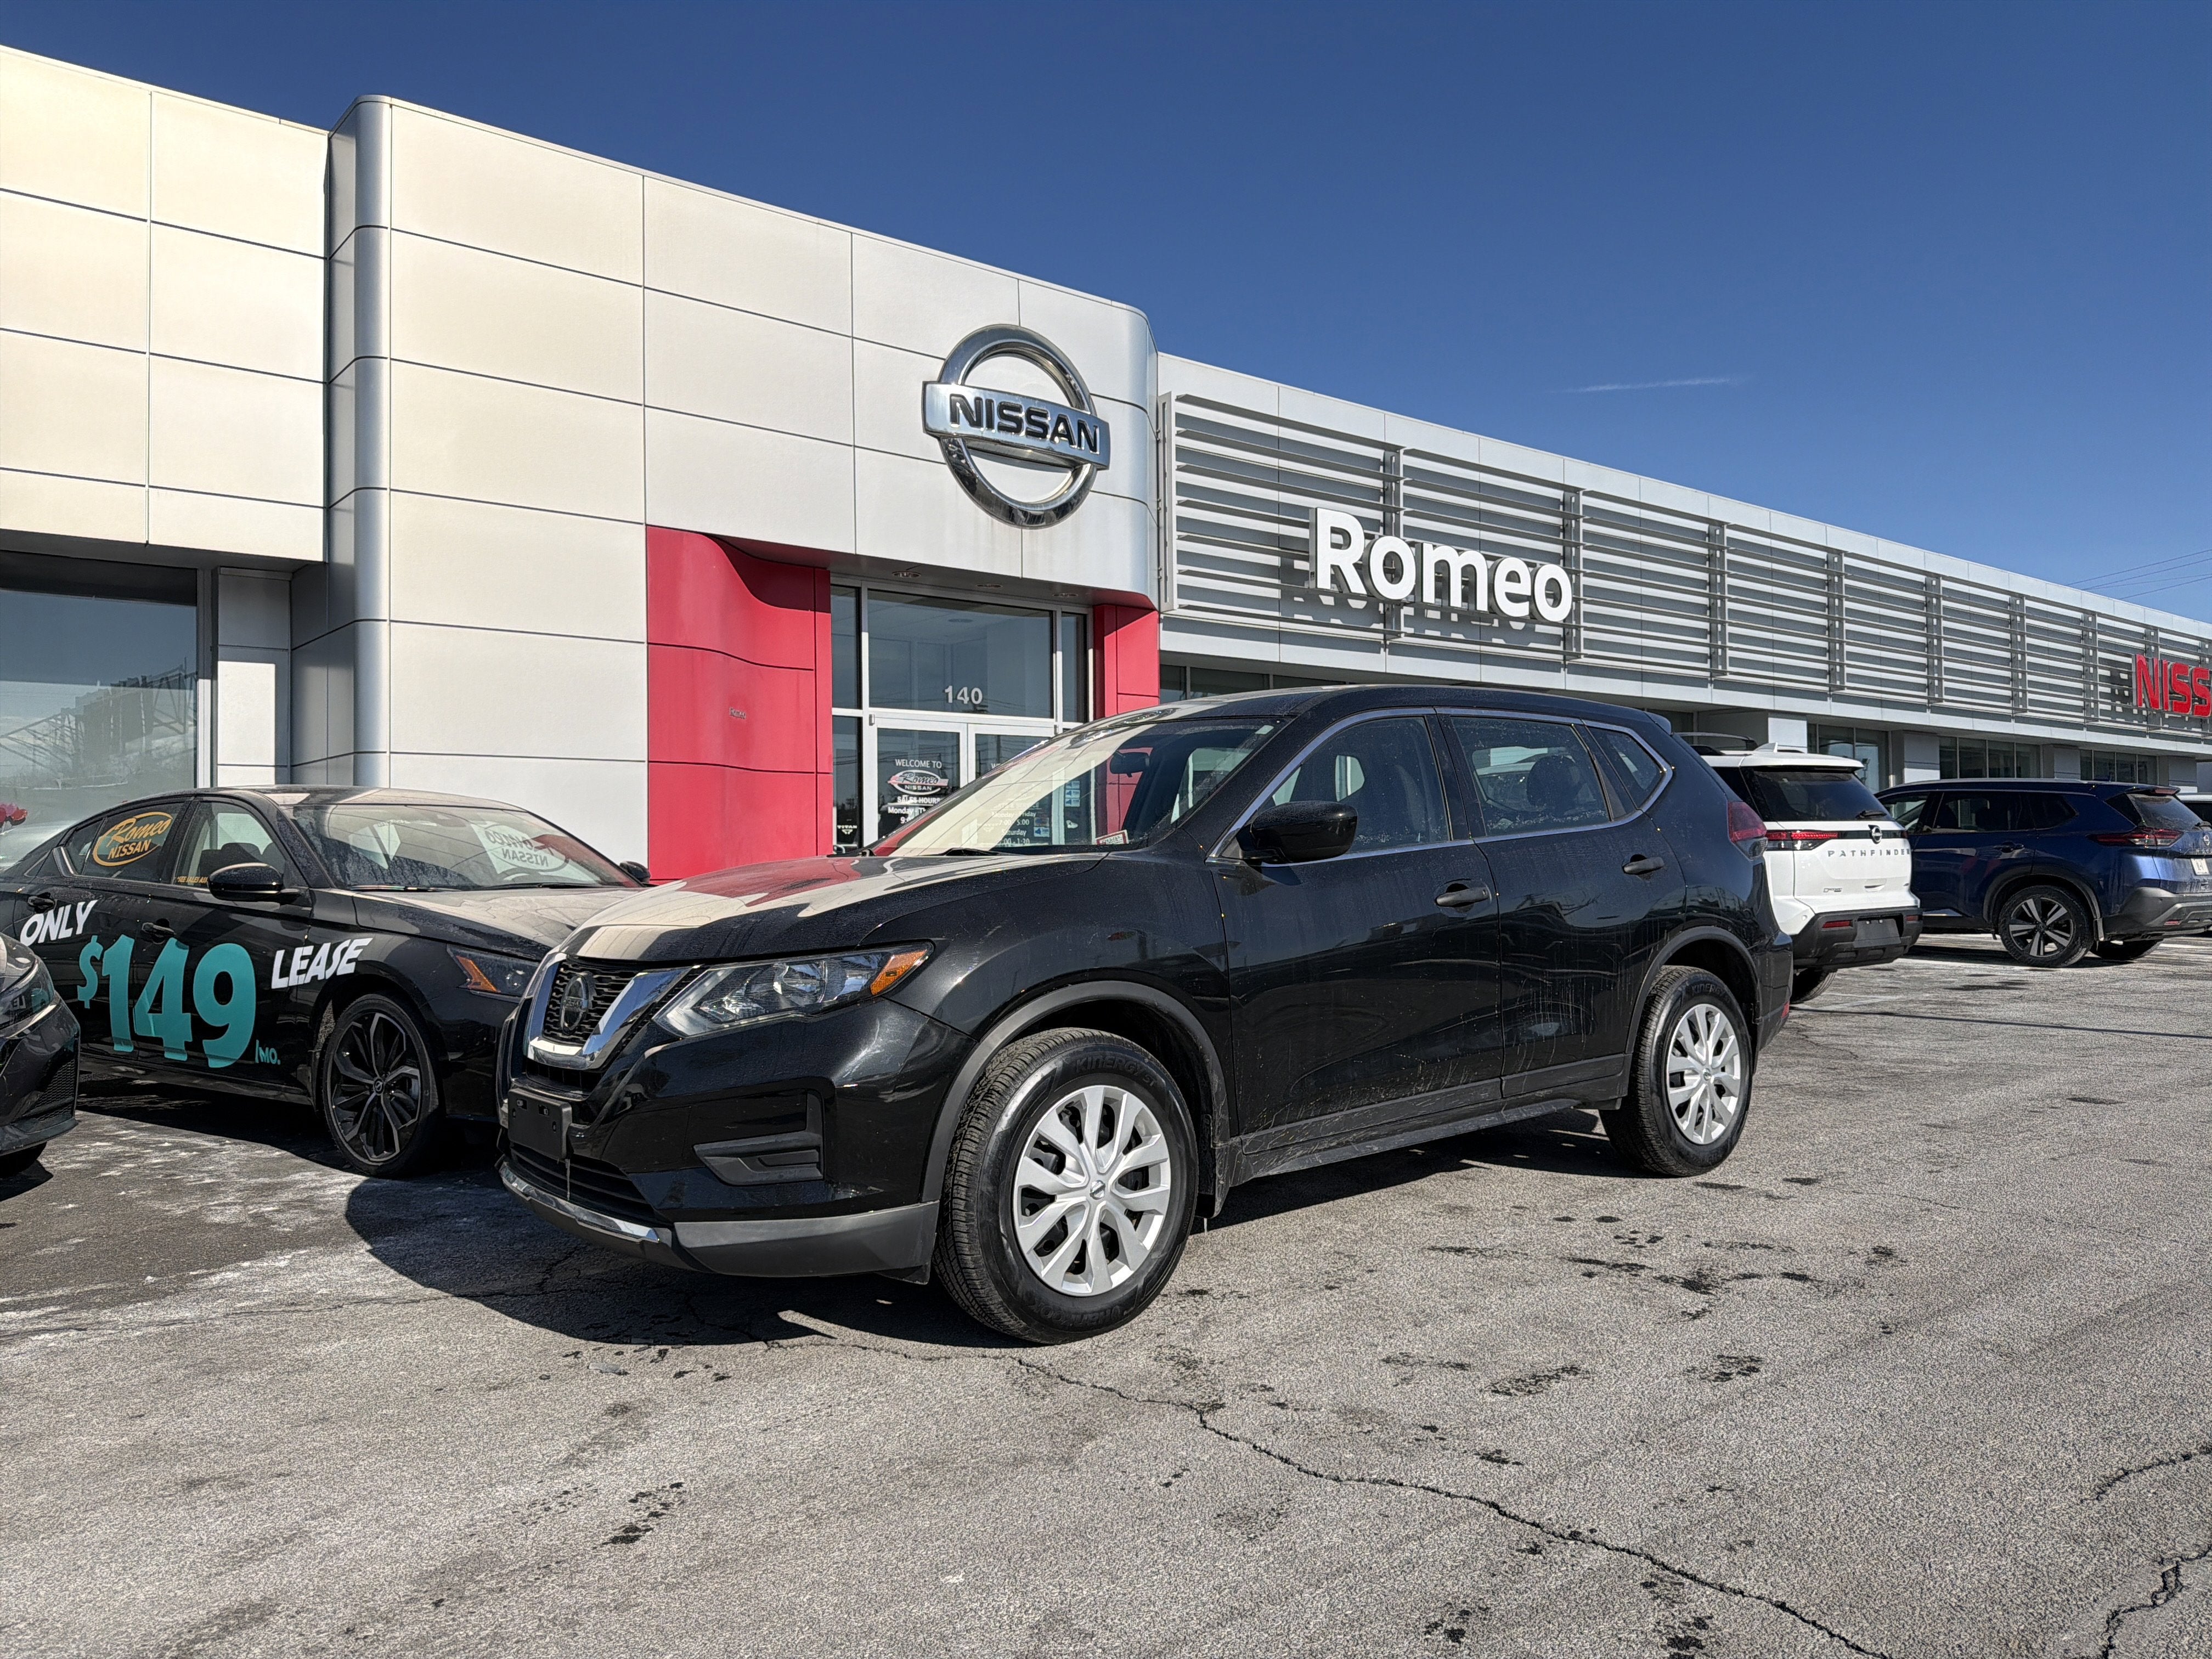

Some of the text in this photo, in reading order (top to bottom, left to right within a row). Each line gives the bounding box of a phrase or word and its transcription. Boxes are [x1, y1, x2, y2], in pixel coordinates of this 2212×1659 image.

[949, 393, 1101, 454] NISSAN
[1312, 507, 1573, 623] Romeo
[945, 685, 983, 704] 140
[2135, 653, 2211, 718] NISS
[895, 759, 930, 768] WELCOME
[899, 772, 939, 785] Romeo
[888, 806, 915, 815] Monday
[106, 817, 173, 848] Romeo
[108, 839, 153, 860] NISSAN
[20, 900, 98, 947] ONLY
[271, 937, 374, 989] LEASE
[77, 934, 256, 1068] $149
